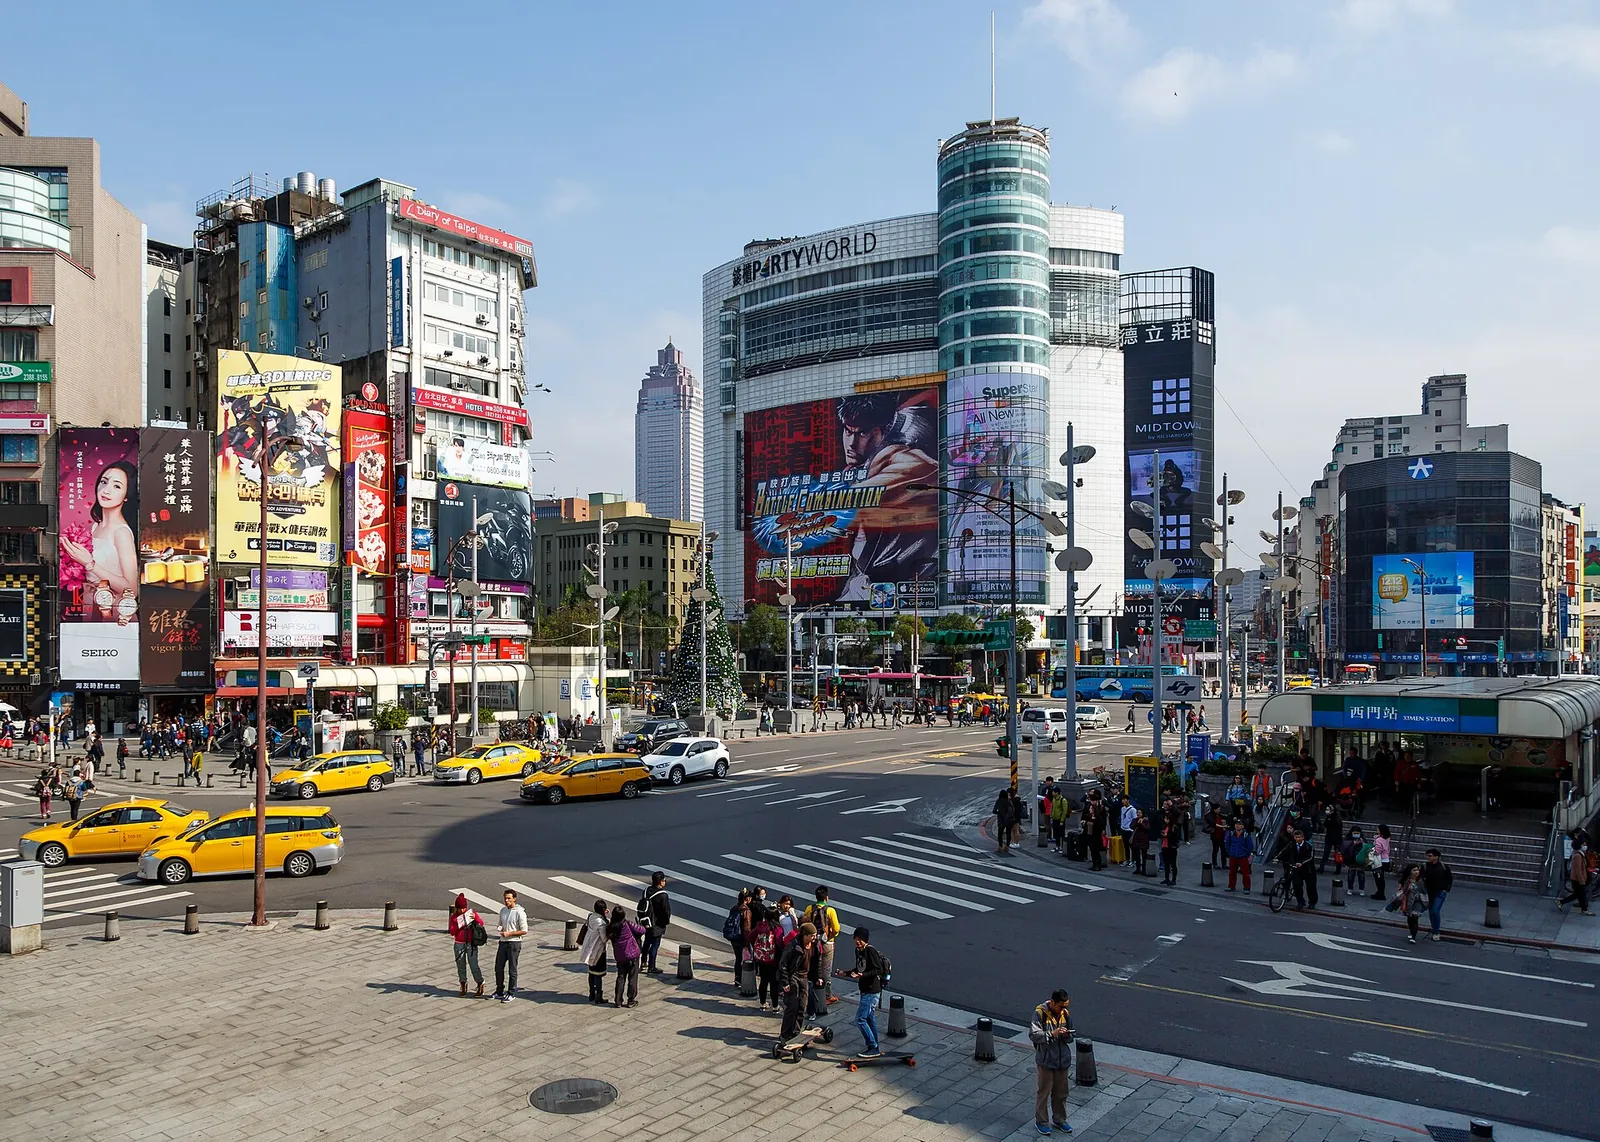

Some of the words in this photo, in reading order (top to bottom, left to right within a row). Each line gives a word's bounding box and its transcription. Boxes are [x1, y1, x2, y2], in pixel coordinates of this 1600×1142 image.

[416, 205, 439, 221] Diary
[441, 217, 451, 225] of
[453, 219, 478, 235] Taipei
[465, 402, 484, 413] HOTEL
[973, 413, 986, 425] All
[988, 408, 1015, 422] New
[179, 438, 193, 514] 華人世界第一品牌
[820, 469, 867, 483] 聯合出擊
[149, 609, 195, 633] 維格
[296, 622, 320, 631] SALON
[81, 649, 118, 657] SEIKO
[150, 643, 177, 654] vigor
[178, 643, 202, 652] kobo
[1350, 706, 1398, 720] 西門站
